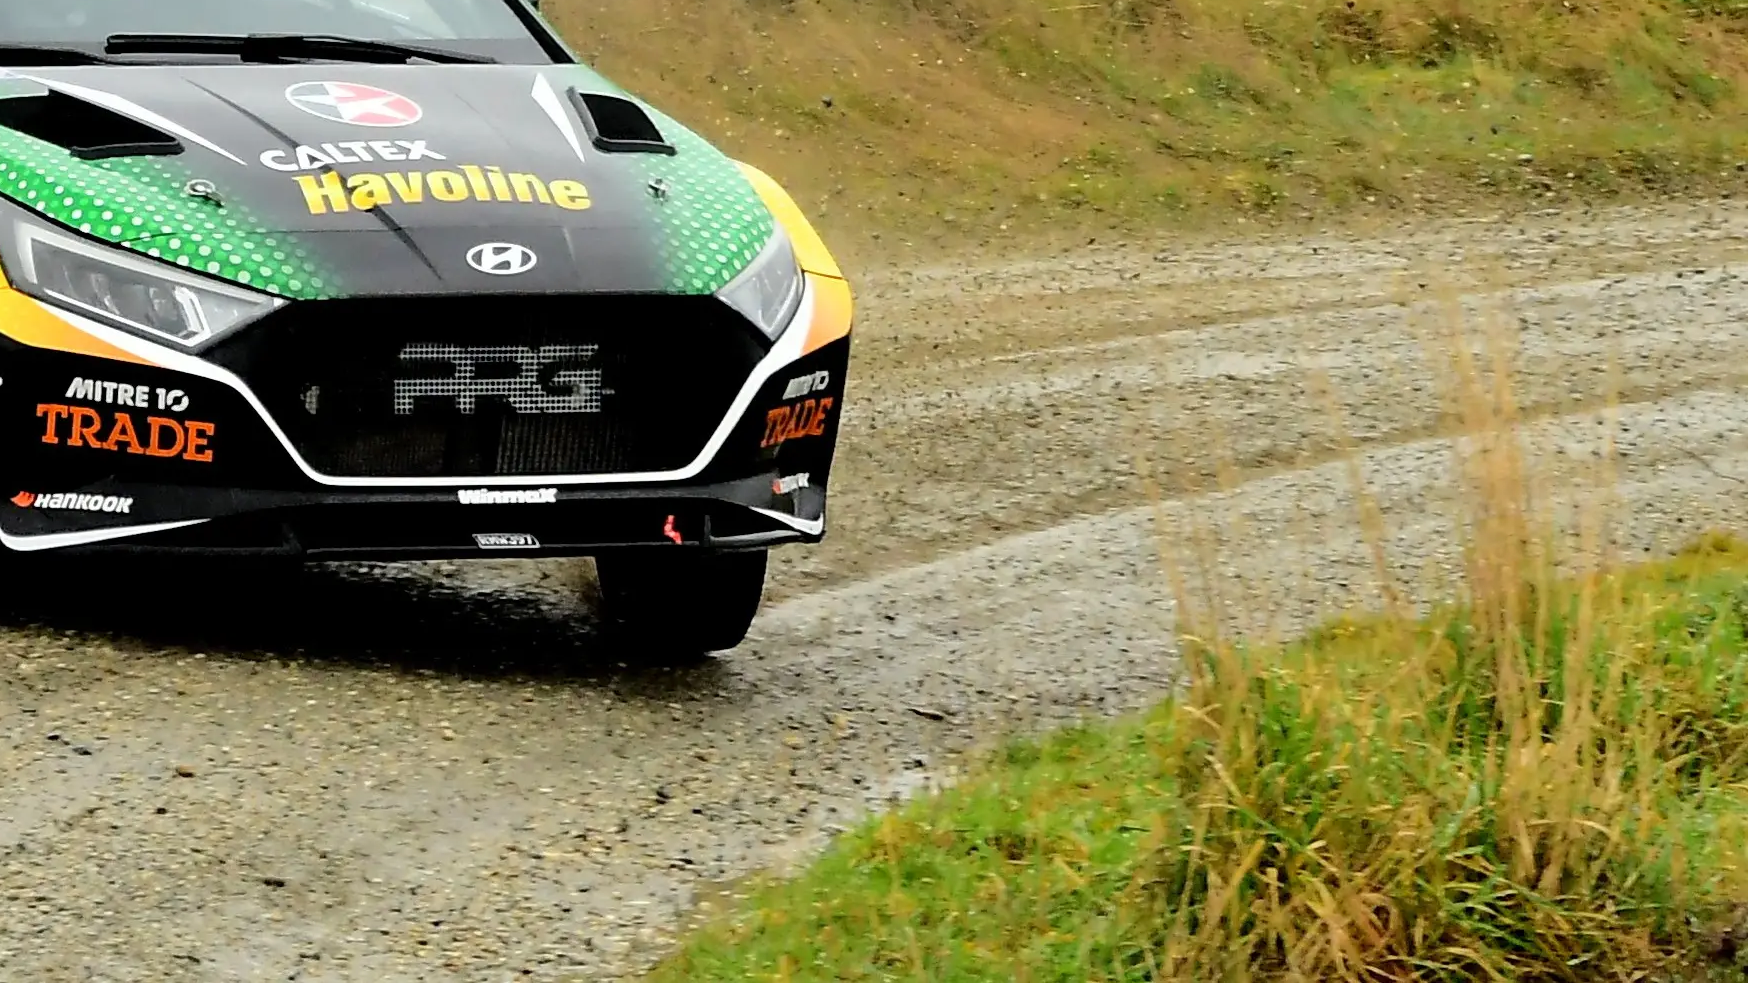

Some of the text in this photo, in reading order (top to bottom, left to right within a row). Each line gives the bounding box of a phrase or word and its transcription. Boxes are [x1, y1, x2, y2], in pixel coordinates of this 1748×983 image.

[259, 140, 447, 171] CALTEX
[292, 165, 592, 215] Havoline
[65, 376, 190, 412] MITRE 10
[36, 403, 215, 462] TRADE
[760, 397, 833, 448] TRADE
